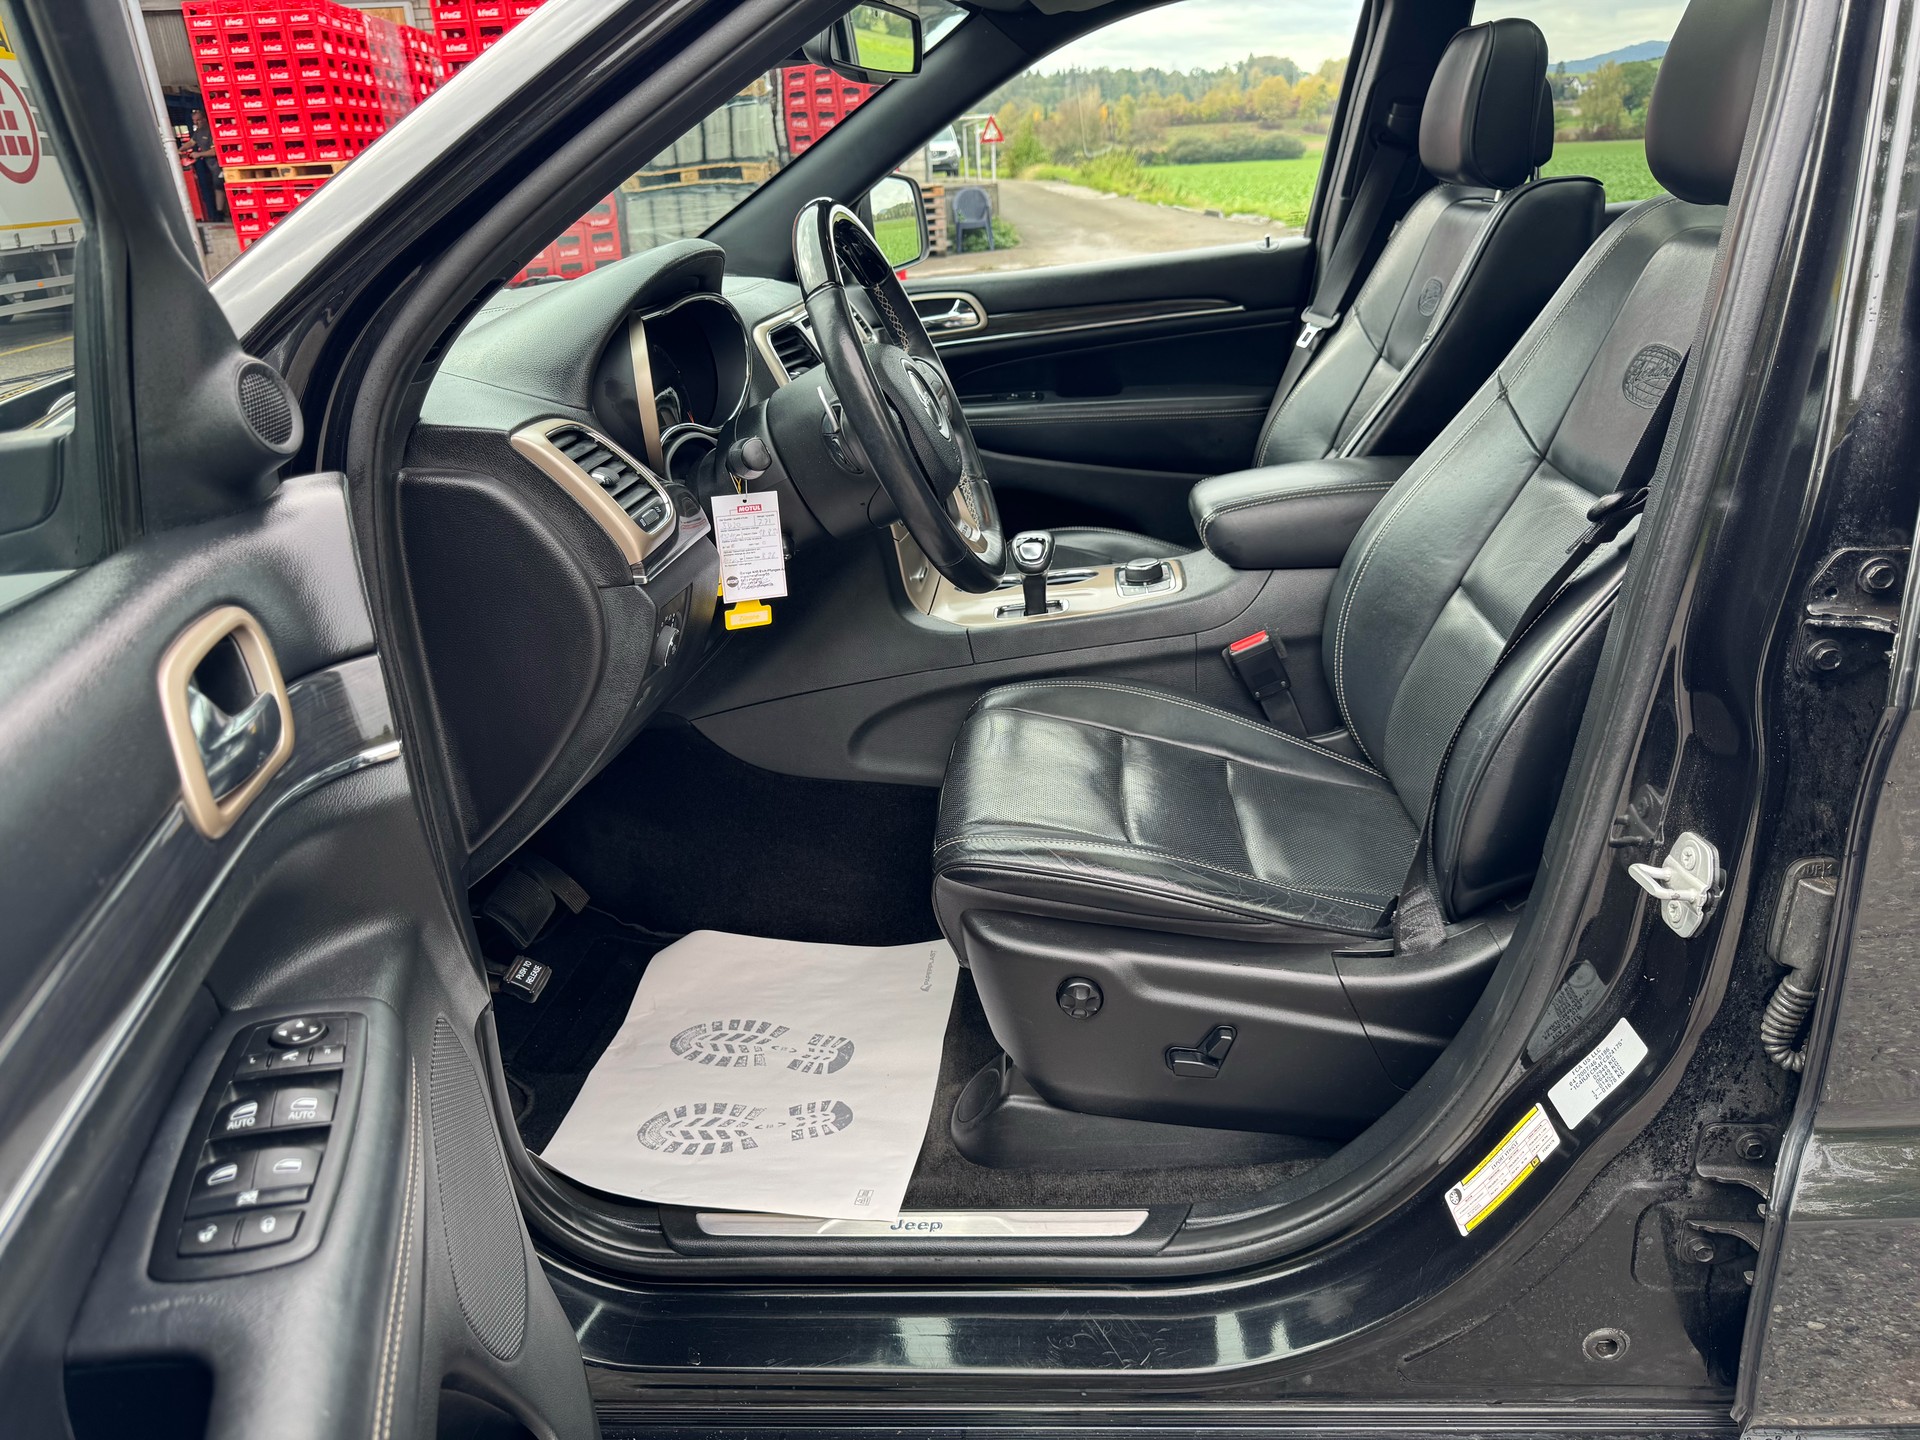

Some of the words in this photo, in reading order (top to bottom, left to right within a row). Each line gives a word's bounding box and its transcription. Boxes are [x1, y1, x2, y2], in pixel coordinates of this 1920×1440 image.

[516, 966, 528, 980] PUSH
[525, 965, 542, 984] RELEASE
[1571, 1065, 1582, 1074] FCA
[1590, 1048, 1601, 1057] LLC
[288, 1110, 316, 1120] AUTO
[226, 1117, 256, 1130] AUTO
[890, 1219, 943, 1232] Jeep
